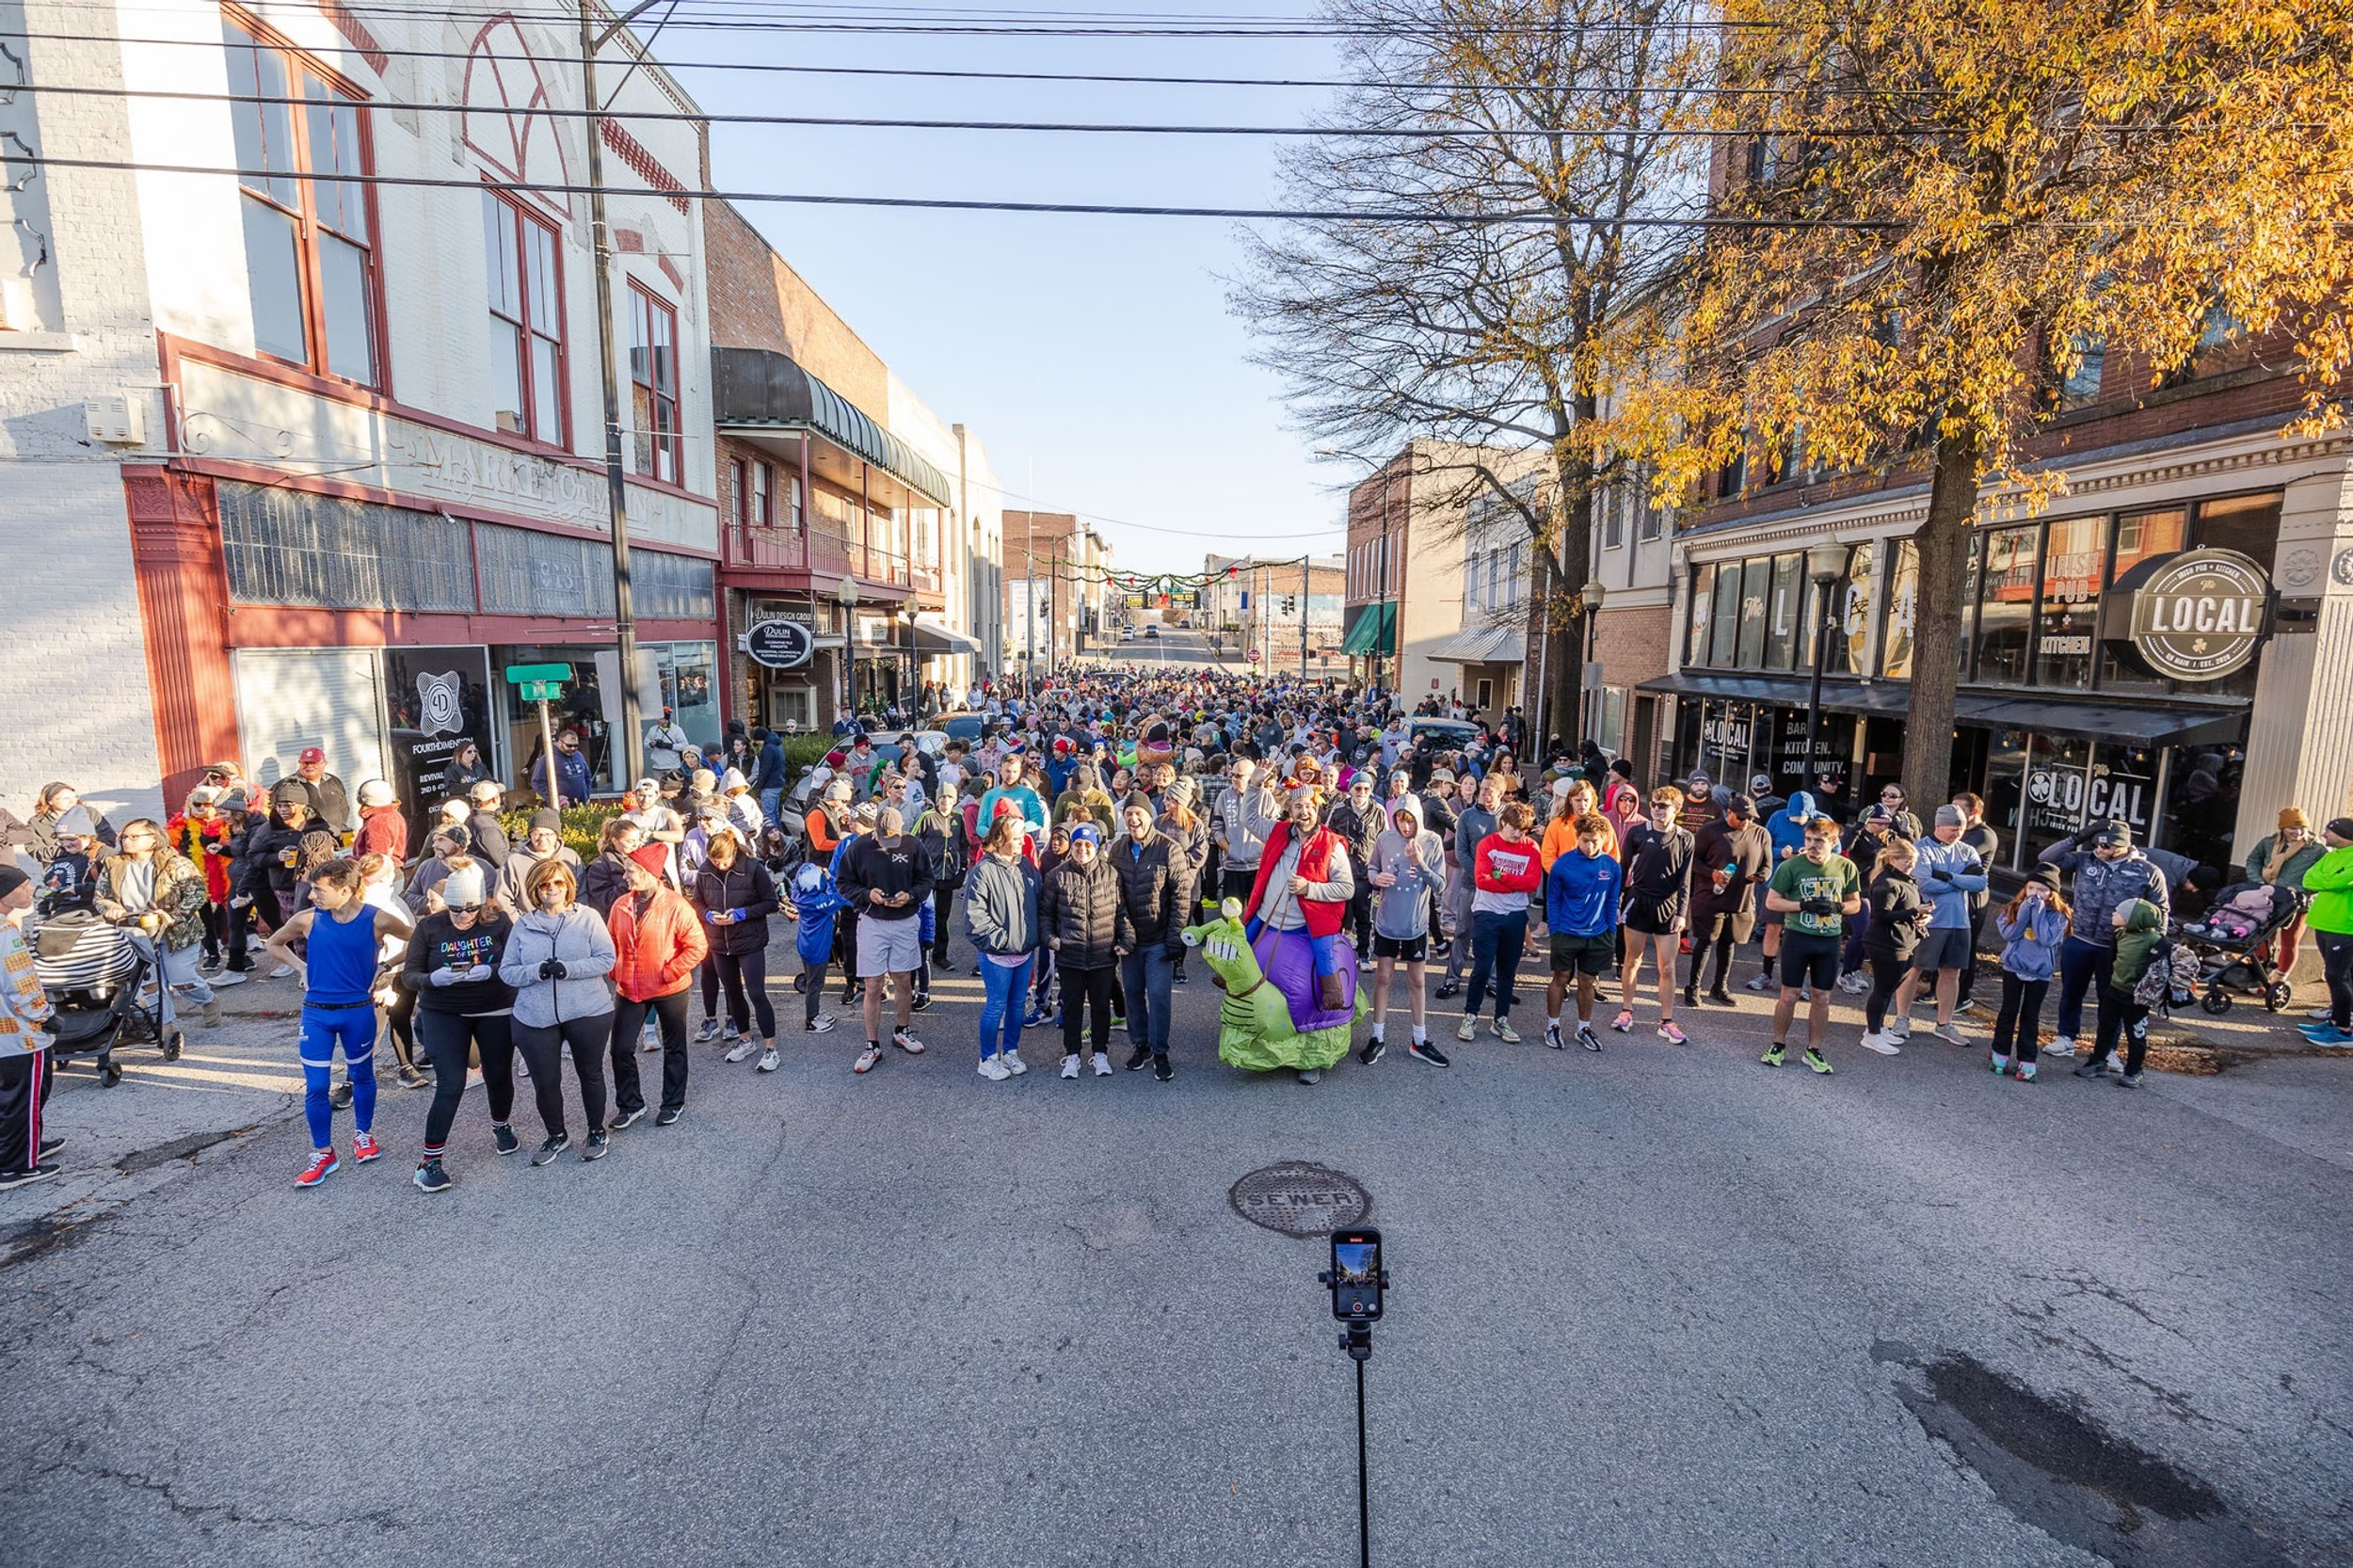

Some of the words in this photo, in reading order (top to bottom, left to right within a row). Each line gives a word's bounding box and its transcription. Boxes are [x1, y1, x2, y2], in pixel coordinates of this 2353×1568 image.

[423, 435, 558, 504] MARKET
[590, 481, 649, 524] MIN
[2050, 552, 2099, 578] IRISH
[2177, 567, 2194, 580] IRISH
[2195, 564, 2208, 572] PUB
[2215, 565, 2241, 580] KITCHEN
[2054, 580, 2089, 602] PUB
[2201, 580, 2217, 591] The
[755, 606, 775, 619] DULIN
[776, 611, 795, 620] DESIGN
[796, 612, 811, 621] GROU
[1744, 596, 1764, 621] The
[2152, 597, 2256, 632] LOCAL
[763, 626, 790, 635] DULIN
[2040, 636, 2089, 653] KITCHEN
[2174, 657, 2189, 666] MAIN
[432, 694, 448, 712] 4D
[1711, 719, 1748, 748] LOCAL
[1783, 761, 1847, 775] COMUNITY.
[2093, 763, 2110, 776] The
[420, 772, 444, 783] REVIVAL
[2047, 772, 2146, 825] LOCAL
[2050, 821, 2066, 830] IRISH
[2067, 824, 2078, 833] PUB
[440, 935, 493, 952] DAUGHTER
[467, 949, 480, 957] THE
[1247, 1192, 1353, 1207] SEWER
